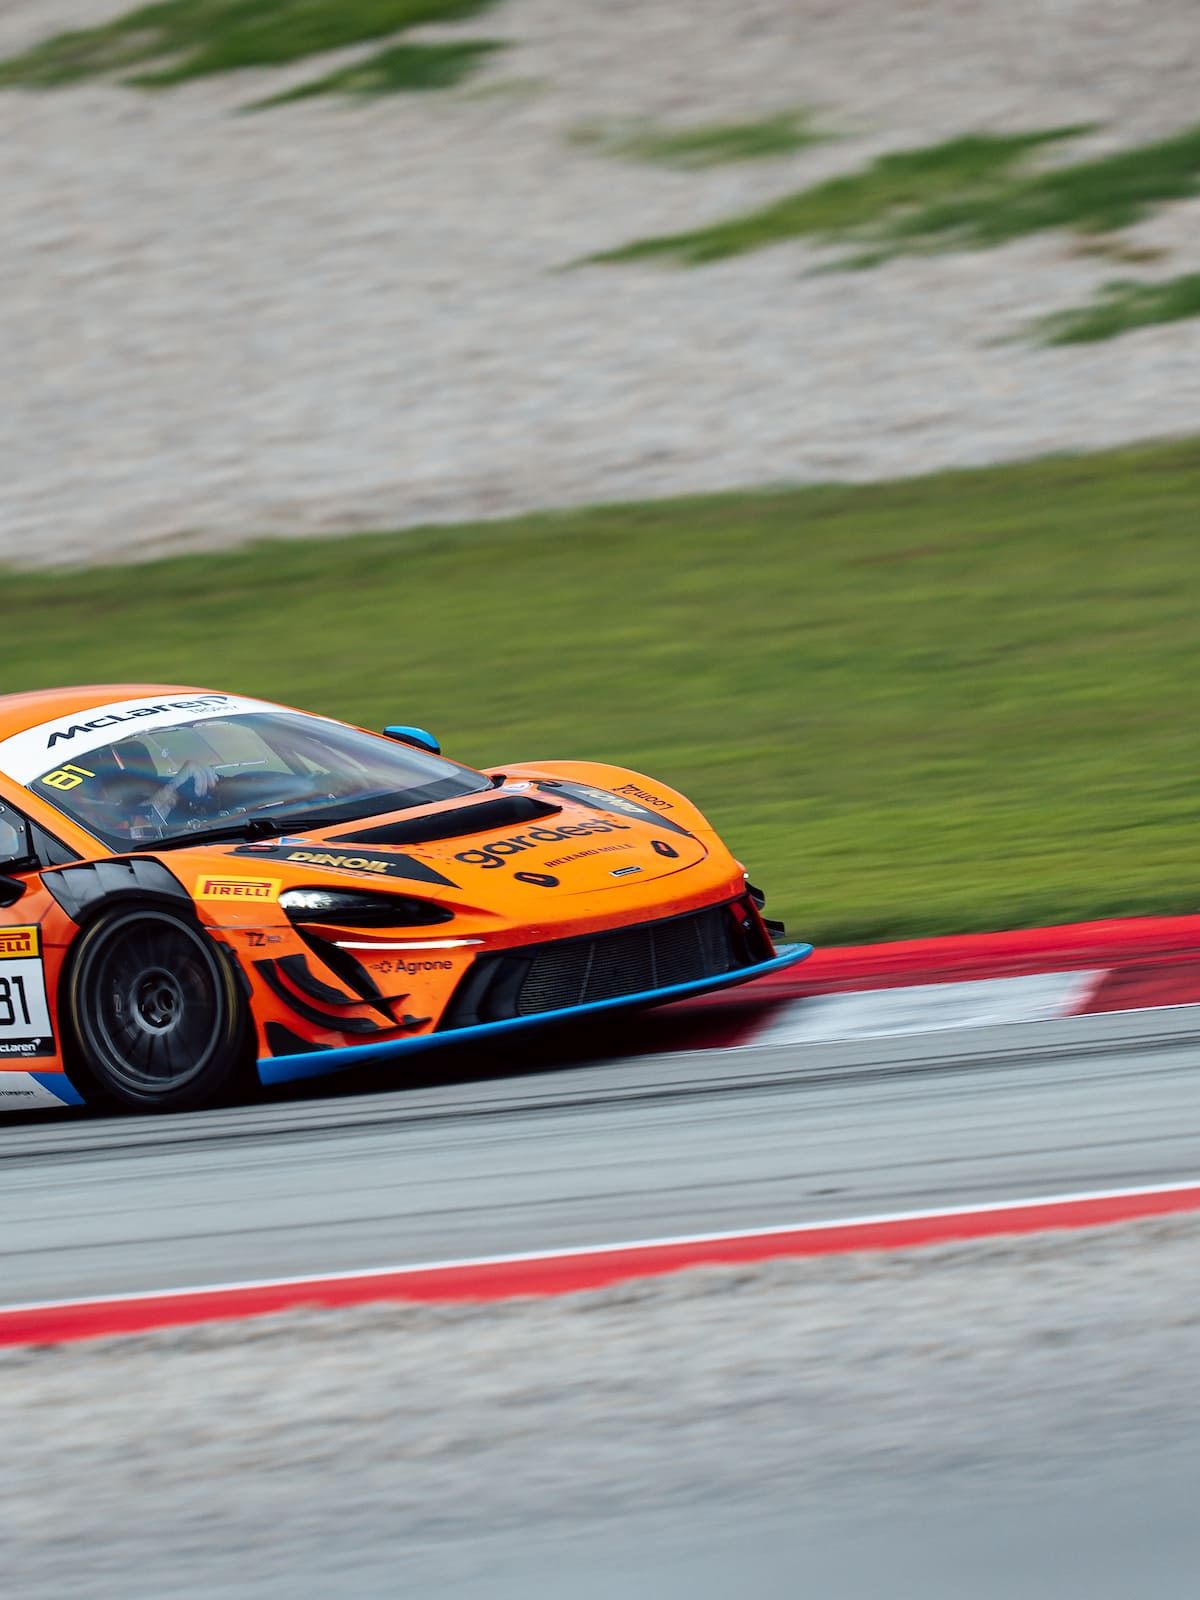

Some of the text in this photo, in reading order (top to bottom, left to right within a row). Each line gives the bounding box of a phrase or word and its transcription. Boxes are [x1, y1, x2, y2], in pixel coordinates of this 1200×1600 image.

[47, 697, 224, 749] McLaren
[41, 764, 96, 791] 81
[611, 784, 674, 810] Loom24
[454, 817, 631, 868] gardest
[286, 851, 390, 873] DINOIL
[543, 849, 599, 868] RICHARD
[203, 880, 272, 897] PIRELLI
[395, 960, 453, 975] Agrone
